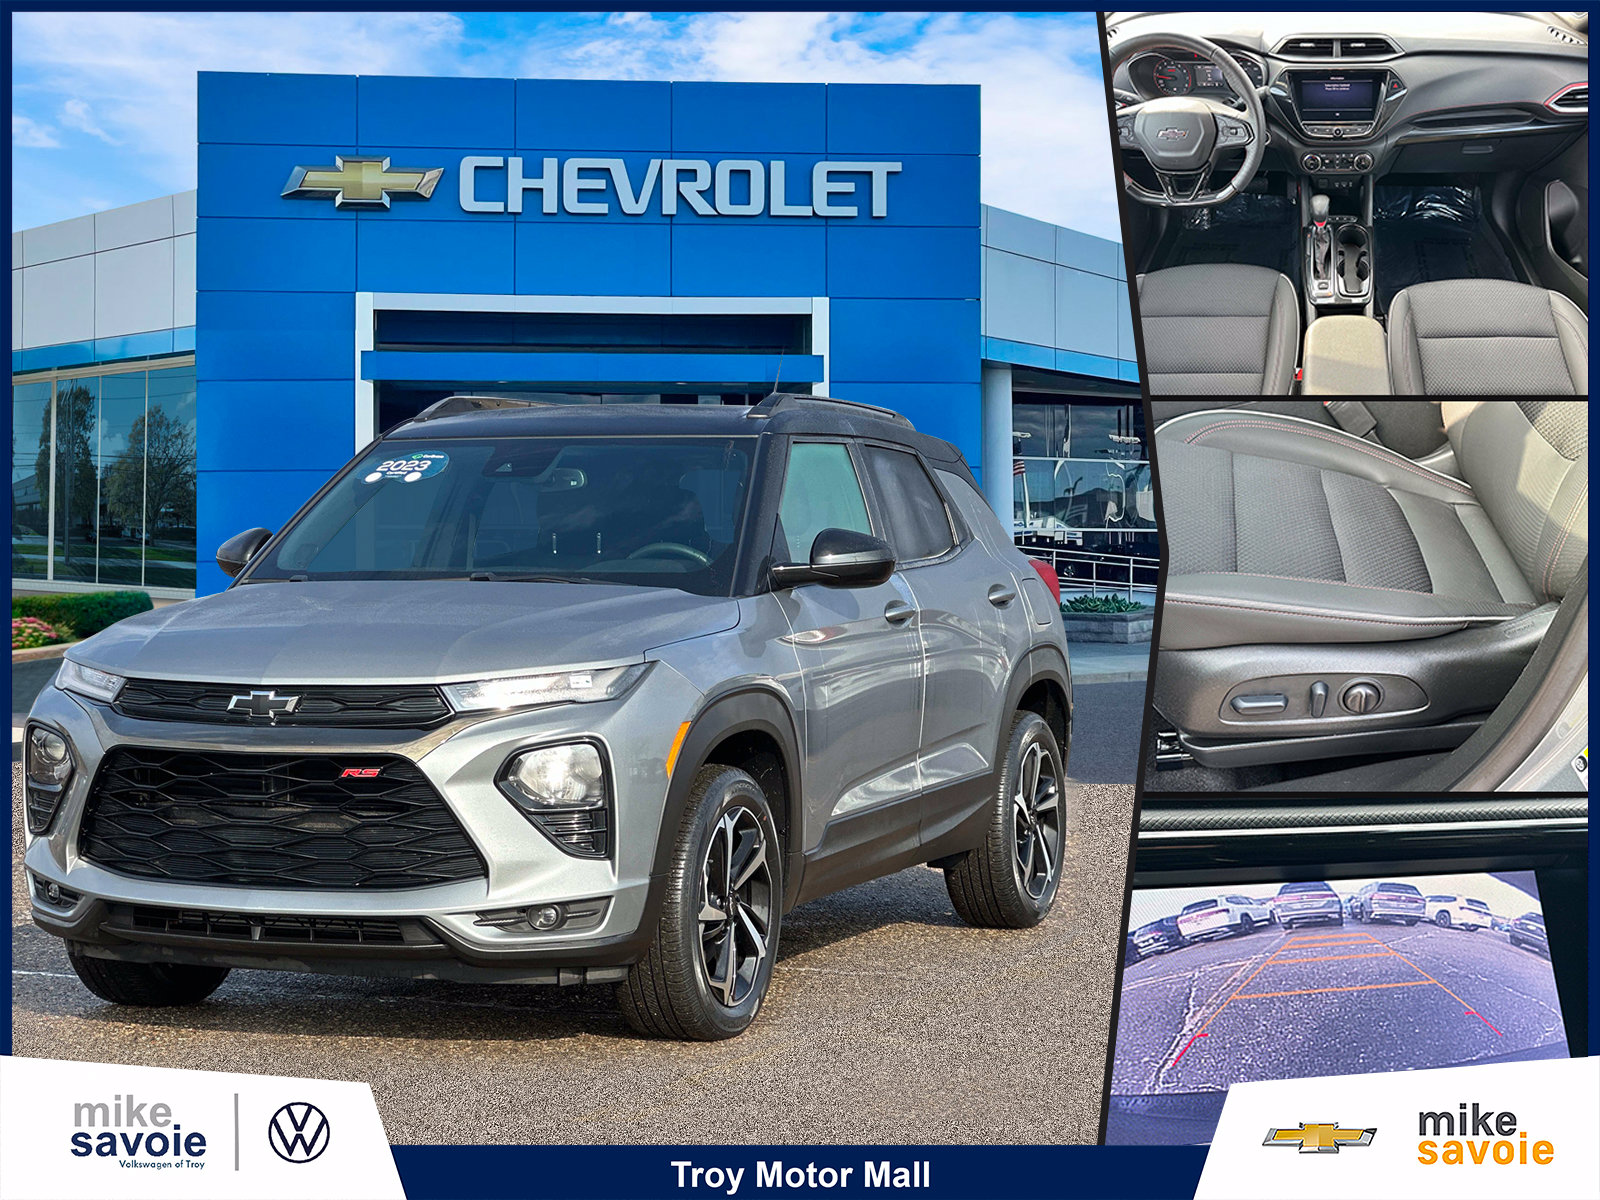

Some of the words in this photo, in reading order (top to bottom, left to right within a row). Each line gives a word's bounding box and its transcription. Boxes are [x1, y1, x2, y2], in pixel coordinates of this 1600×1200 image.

[459, 155, 903, 217] CHEVROLET
[376, 459, 432, 471] 2023
[341, 768, 381, 778] RS
